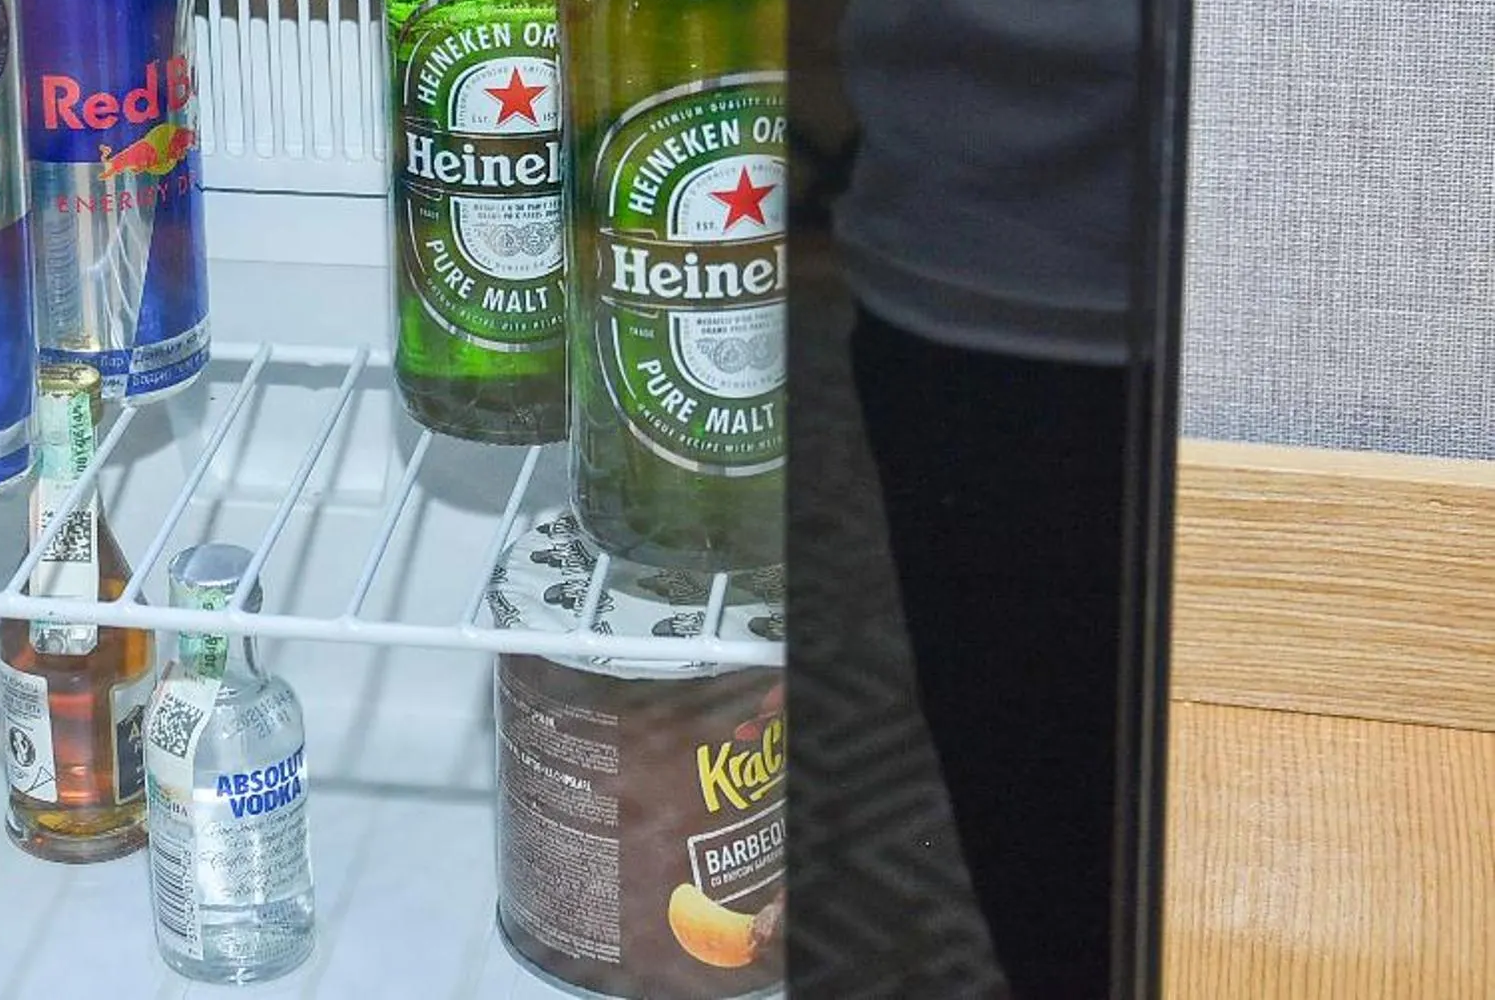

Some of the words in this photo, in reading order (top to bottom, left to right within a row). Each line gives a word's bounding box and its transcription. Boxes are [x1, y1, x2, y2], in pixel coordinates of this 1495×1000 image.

[42, 62, 161, 130] Red
[417, 23, 511, 105] HEINEKEN
[58, 183, 169, 214] ENERGY
[628, 117, 741, 215] HEINEKEN
[425, 239, 475, 300] PURE
[481, 285, 548, 313] MALT
[637, 360, 698, 423] PURE
[705, 402, 775, 435] MALT
[217, 746, 304, 798] ABSOLUT
[229, 776, 303, 819] VODKA
